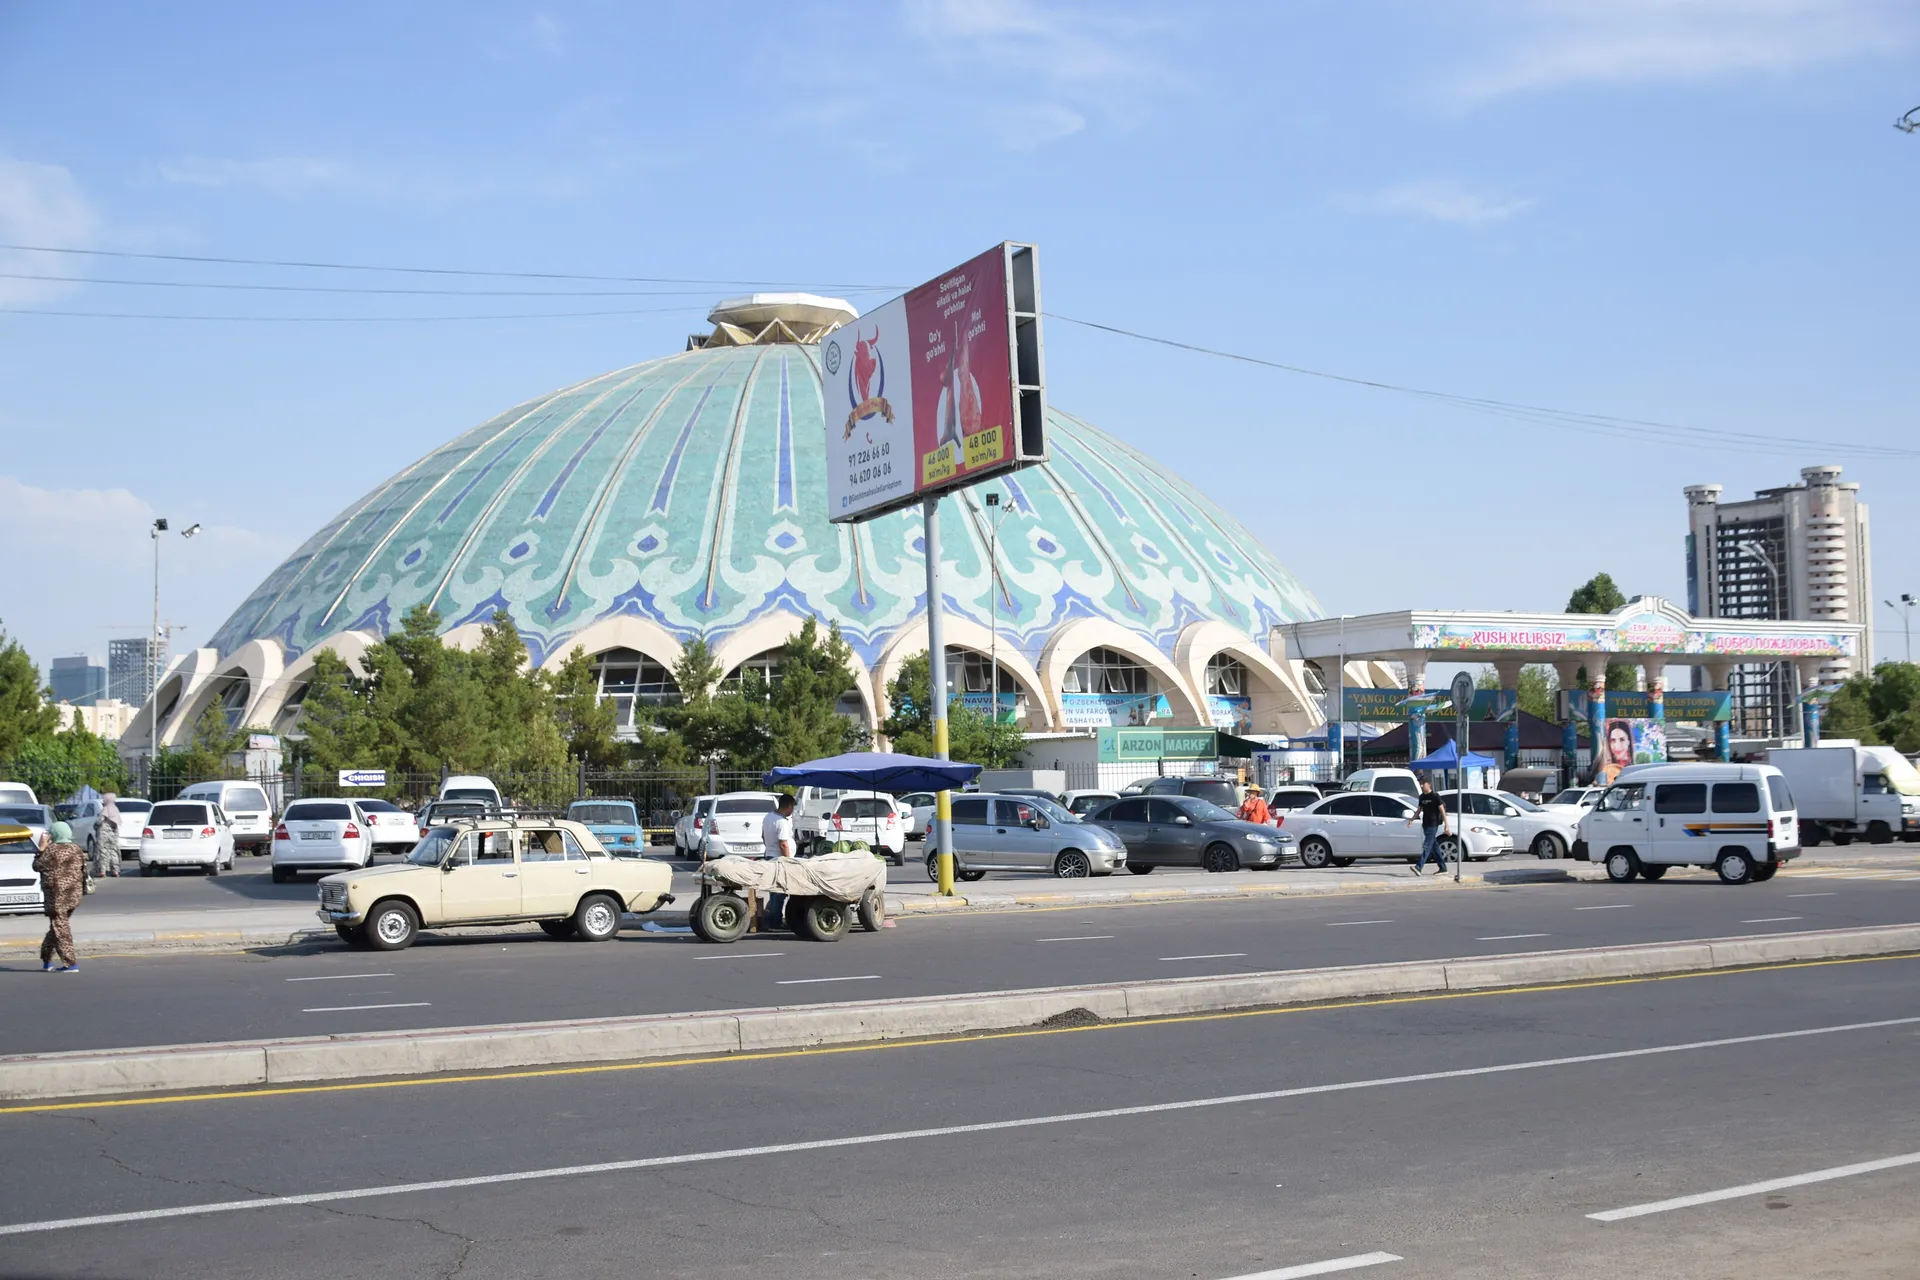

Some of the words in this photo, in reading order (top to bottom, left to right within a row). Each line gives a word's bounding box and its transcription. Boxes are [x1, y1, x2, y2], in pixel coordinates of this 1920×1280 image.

[951, 290, 958, 300] va
[969, 436, 979, 449] 48
[981, 430, 997, 446] 000
[848, 453, 856, 468] 97
[857, 449, 871, 465] 226
[872, 445, 880, 460] 66
[881, 442, 890, 456] 60
[928, 452, 936, 465] 46
[937, 447, 950, 462] 000
[849, 472, 858, 486] 94
[859, 468, 871, 484] 620
[872, 465, 882, 479] 06
[882, 461, 892, 475] 06
[1472, 631, 1506, 645] XUSH
[1509, 631, 1567, 646] KELIBSIZ!
[1716, 635, 1752, 649] ДОБРО
[1754, 636, 1830, 650] ПОЖАЛОВАТЬ
[1617, 708, 1629, 717] EL
[1121, 739, 1162, 752] ARZON
[1165, 738, 1212, 752] MARKET
[348, 774, 385, 782] CHIQISH
